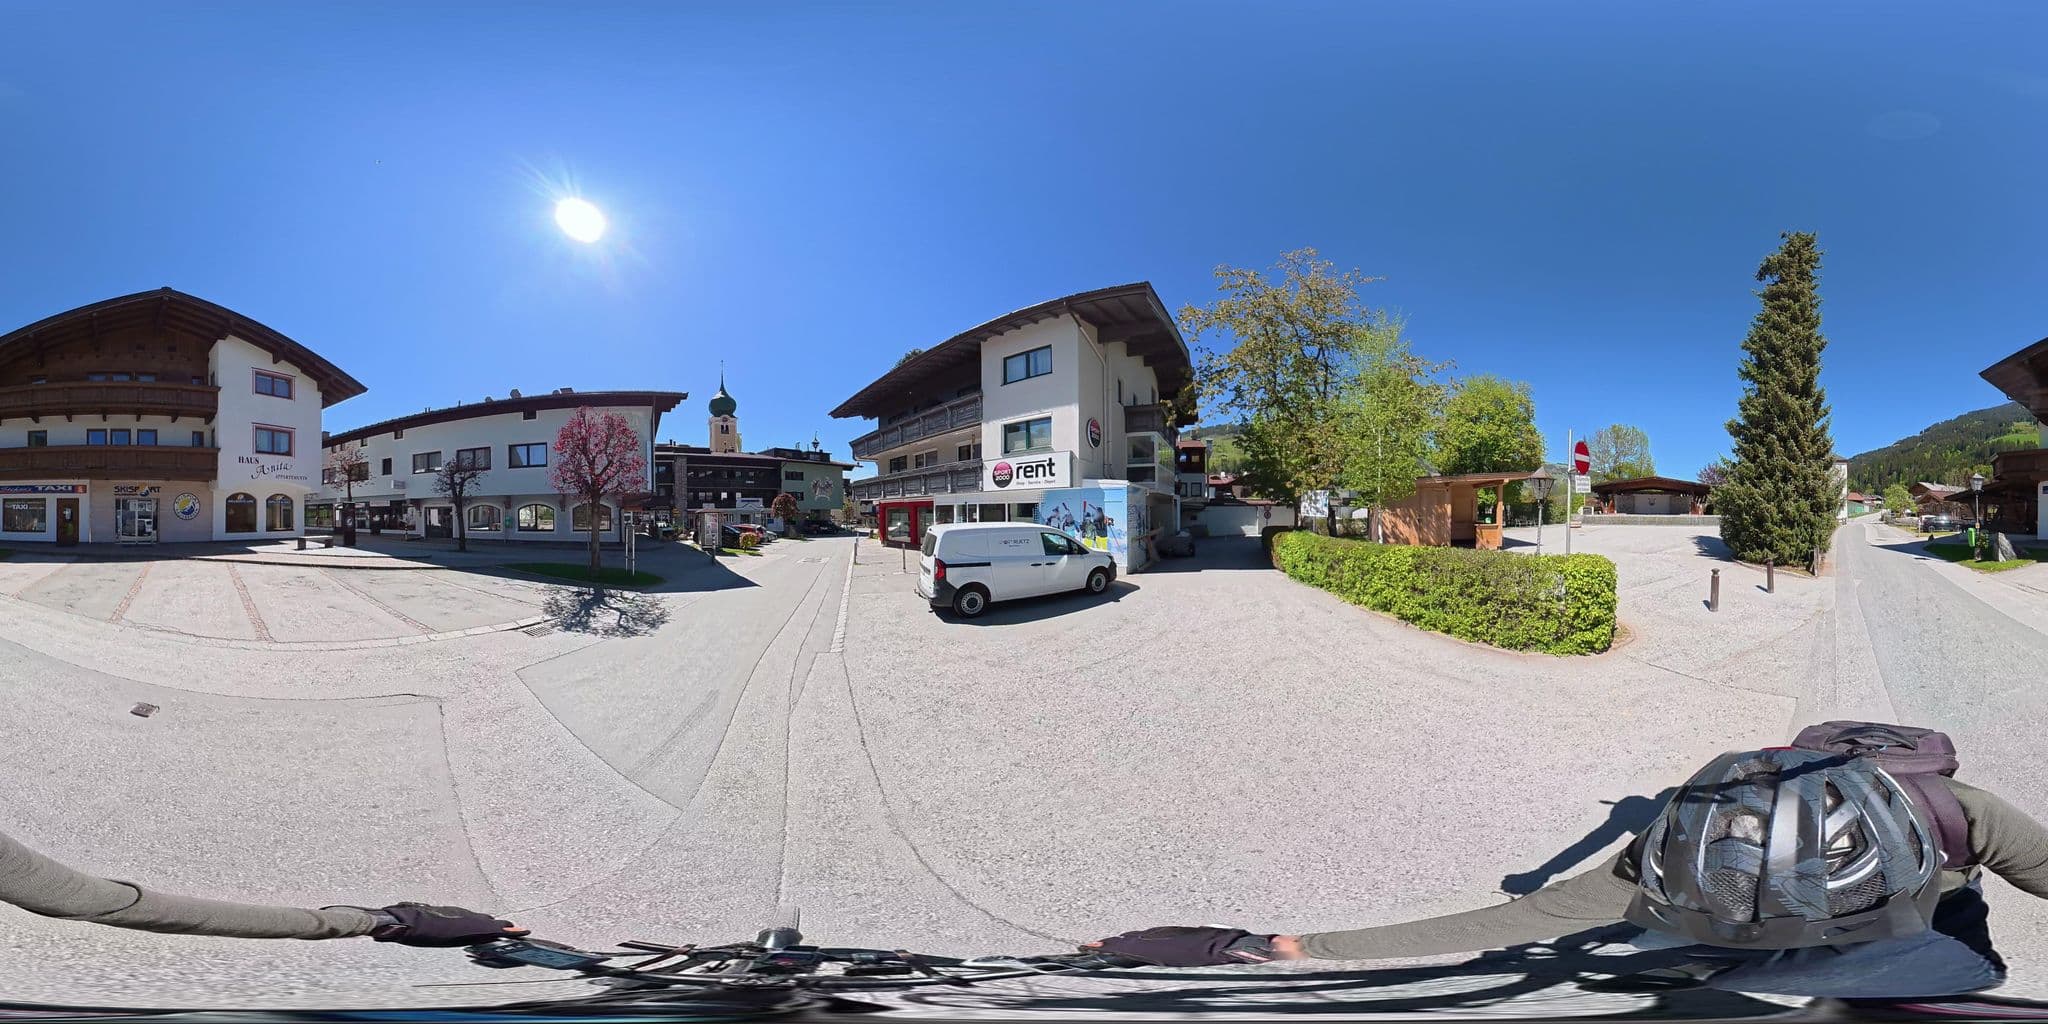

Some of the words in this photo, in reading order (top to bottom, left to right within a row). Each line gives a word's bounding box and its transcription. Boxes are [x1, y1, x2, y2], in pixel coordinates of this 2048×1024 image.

[238, 456, 259, 465] HAUS
[1016, 457, 1056, 480] rent
[251, 462, 293, 480] Anita
